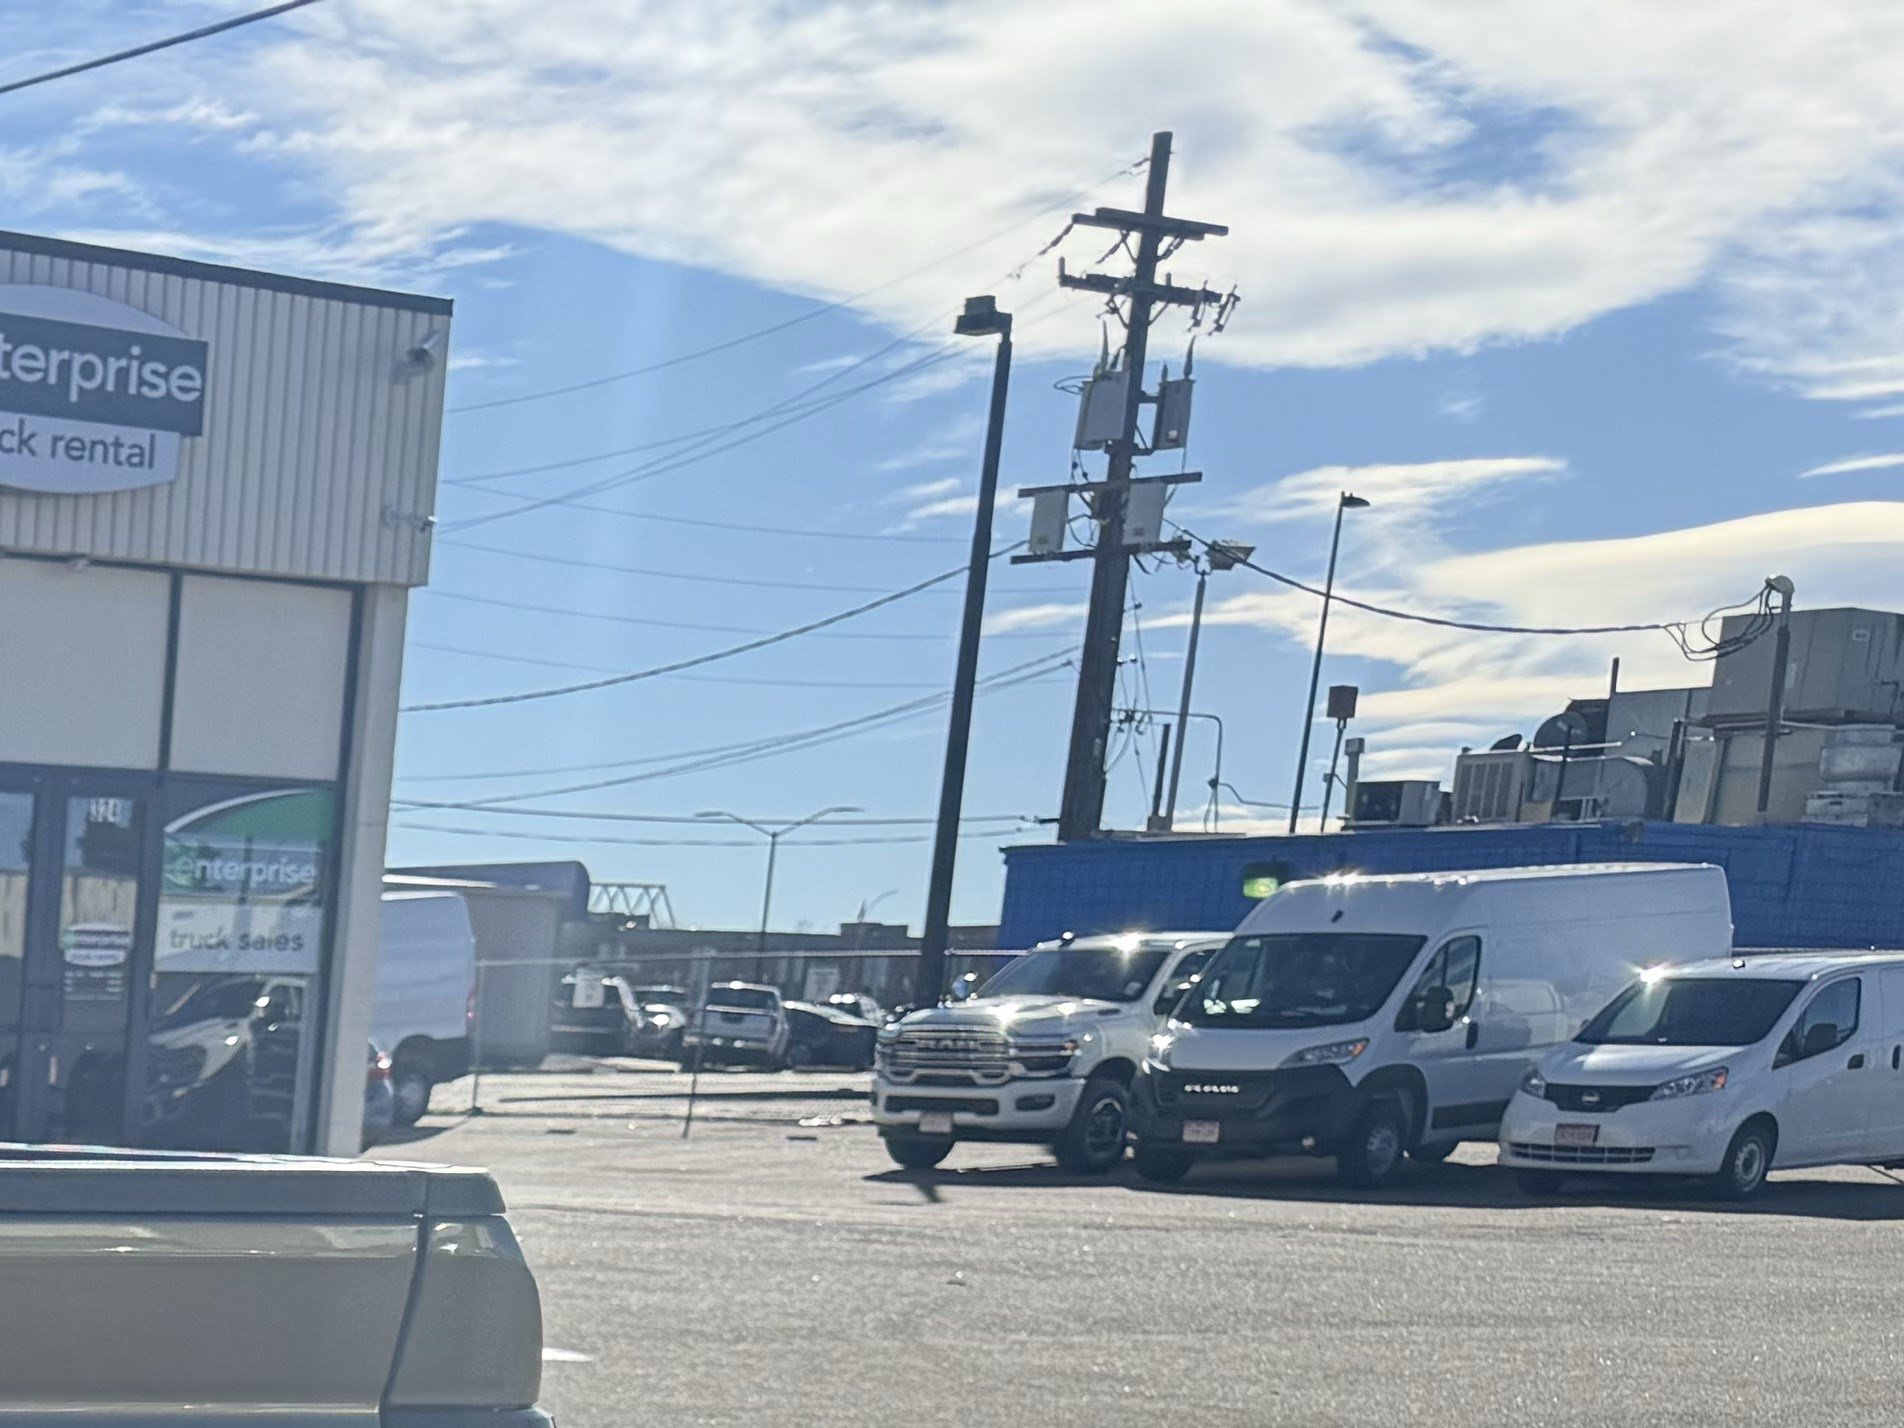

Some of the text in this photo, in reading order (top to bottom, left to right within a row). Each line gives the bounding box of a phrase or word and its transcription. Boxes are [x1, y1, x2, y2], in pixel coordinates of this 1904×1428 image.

[50, 432, 156, 470] rental
[168, 855, 316, 890] enterprise
[169, 927, 305, 951] truck sales
